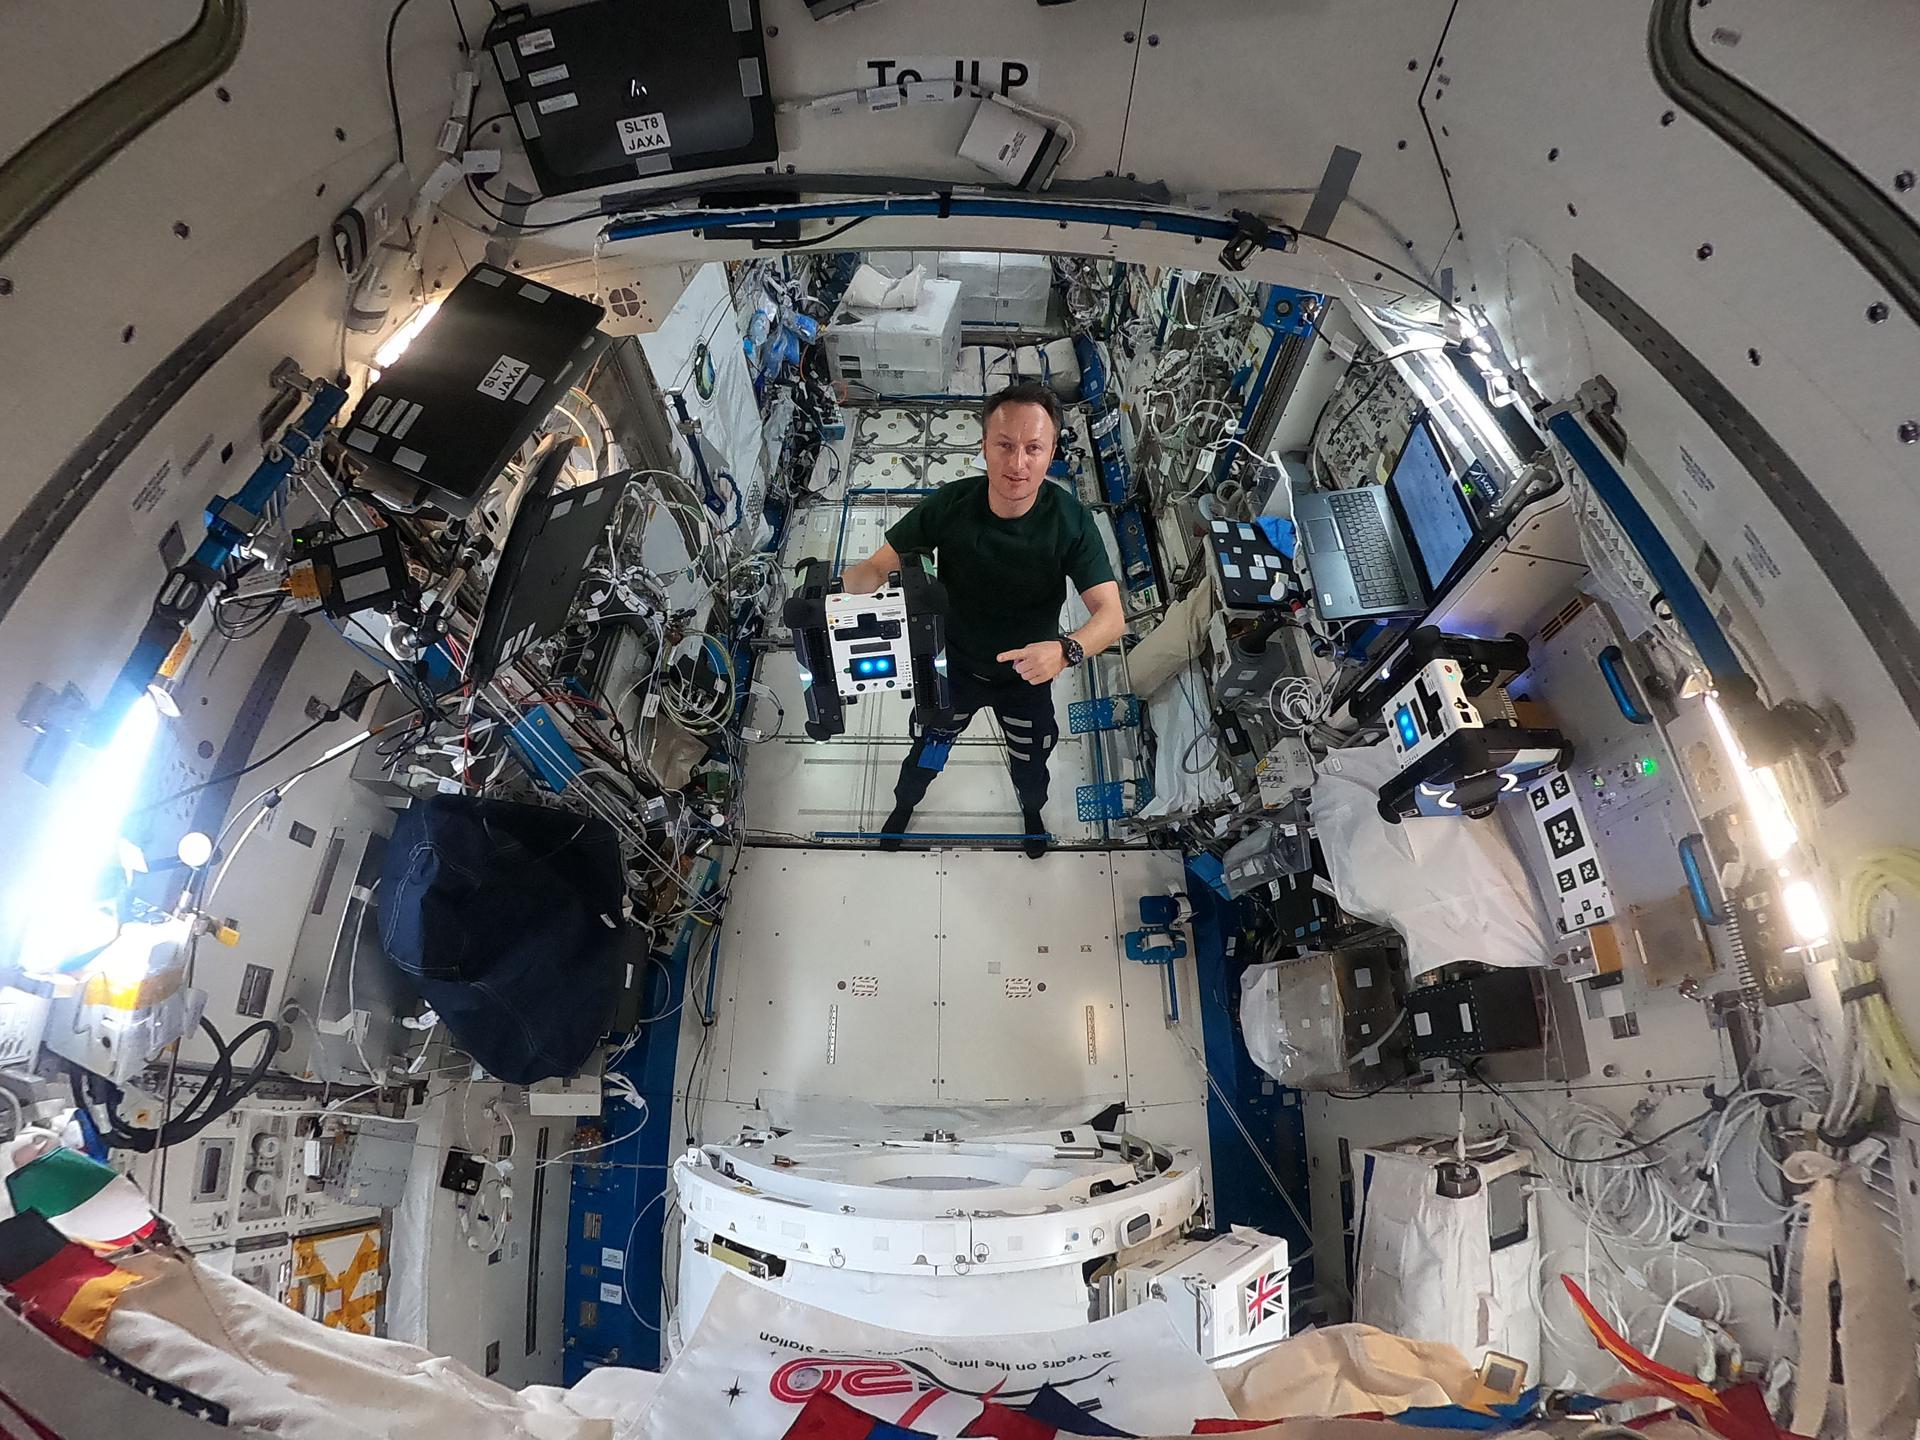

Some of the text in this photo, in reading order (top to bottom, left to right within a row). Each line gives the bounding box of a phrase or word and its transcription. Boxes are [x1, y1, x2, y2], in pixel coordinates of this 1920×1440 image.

[867, 60, 923, 98] To
[624, 117, 659, 134] SLT8
[628, 134, 666, 151] JAXA
[483, 360, 508, 388] SLT7
[498, 366, 525, 396] JAXA
[759, 1330, 814, 1354] Station
[1042, 1354, 1089, 1370] Years
[1092, 1350, 1113, 1360] 20
[984, 1359, 1012, 1372] the
[1016, 1363, 1038, 1372] on
